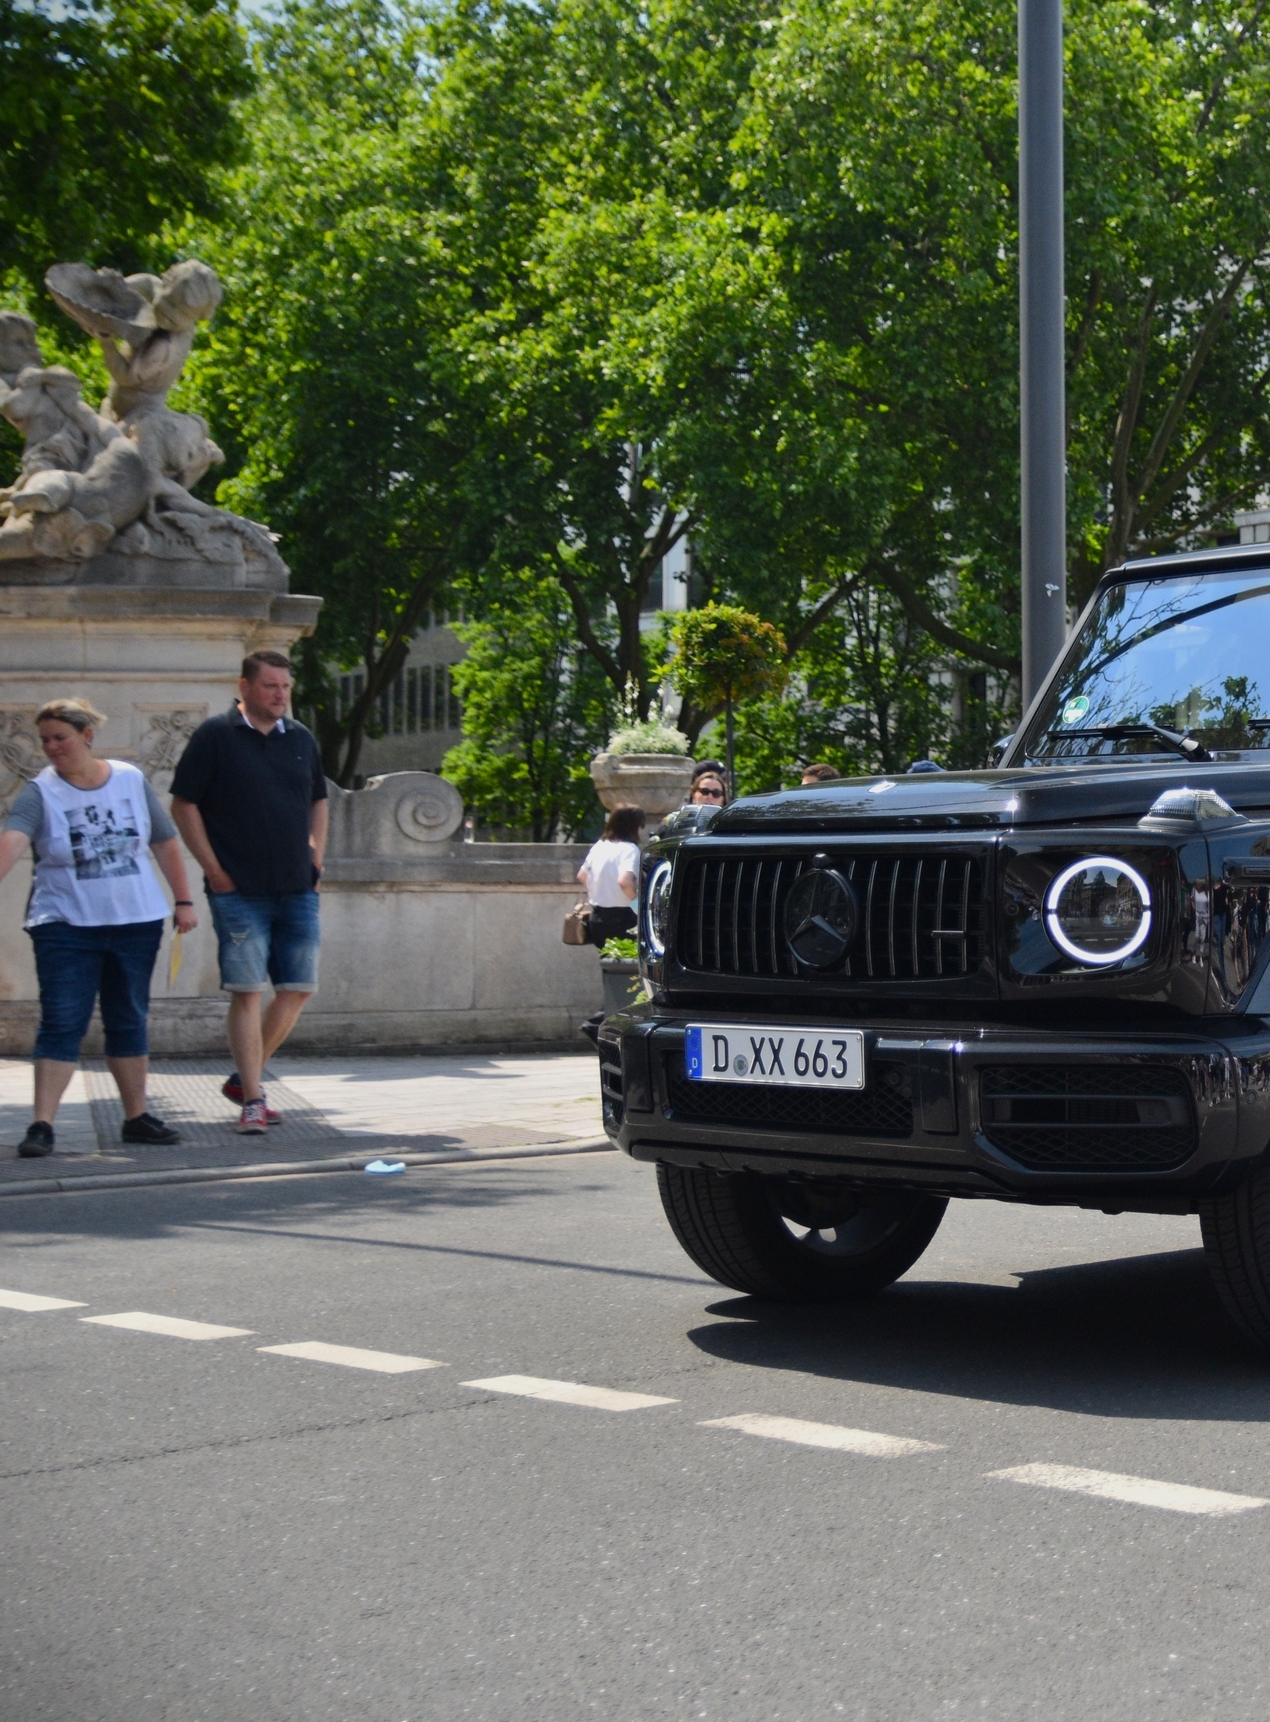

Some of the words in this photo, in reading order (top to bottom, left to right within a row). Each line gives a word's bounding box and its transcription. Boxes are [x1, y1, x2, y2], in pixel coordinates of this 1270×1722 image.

[692, 1058, 699, 1068] D
[712, 1035, 729, 1072] D
[750, 1037, 785, 1075] XX
[794, 1038, 847, 1078] 663
